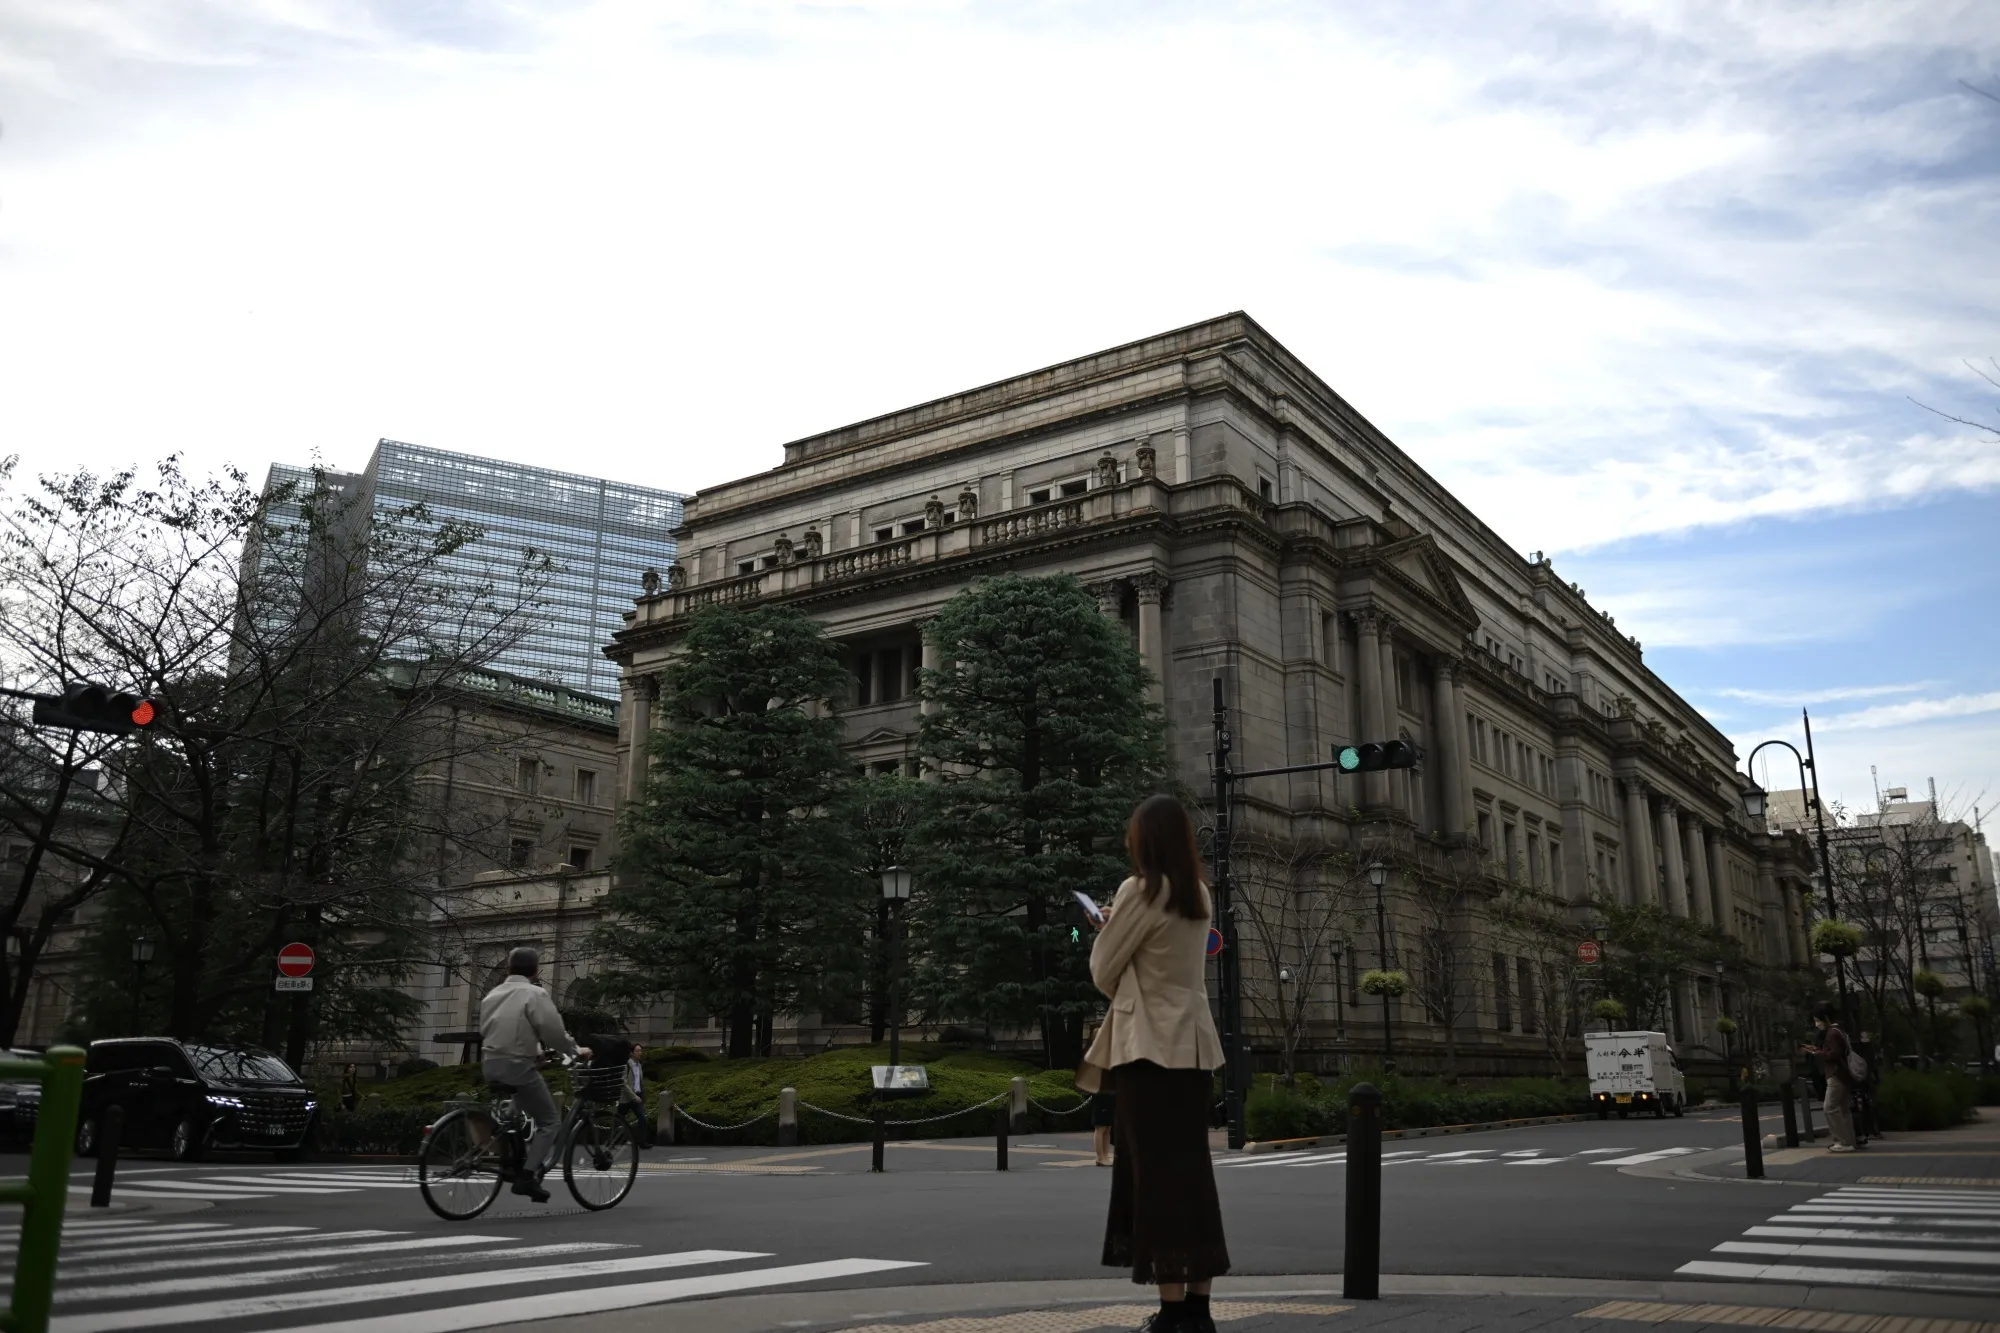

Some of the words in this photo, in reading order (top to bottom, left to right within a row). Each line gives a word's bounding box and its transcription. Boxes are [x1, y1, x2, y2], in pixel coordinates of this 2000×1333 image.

[278, 980, 311, 989] 自転車を除く
